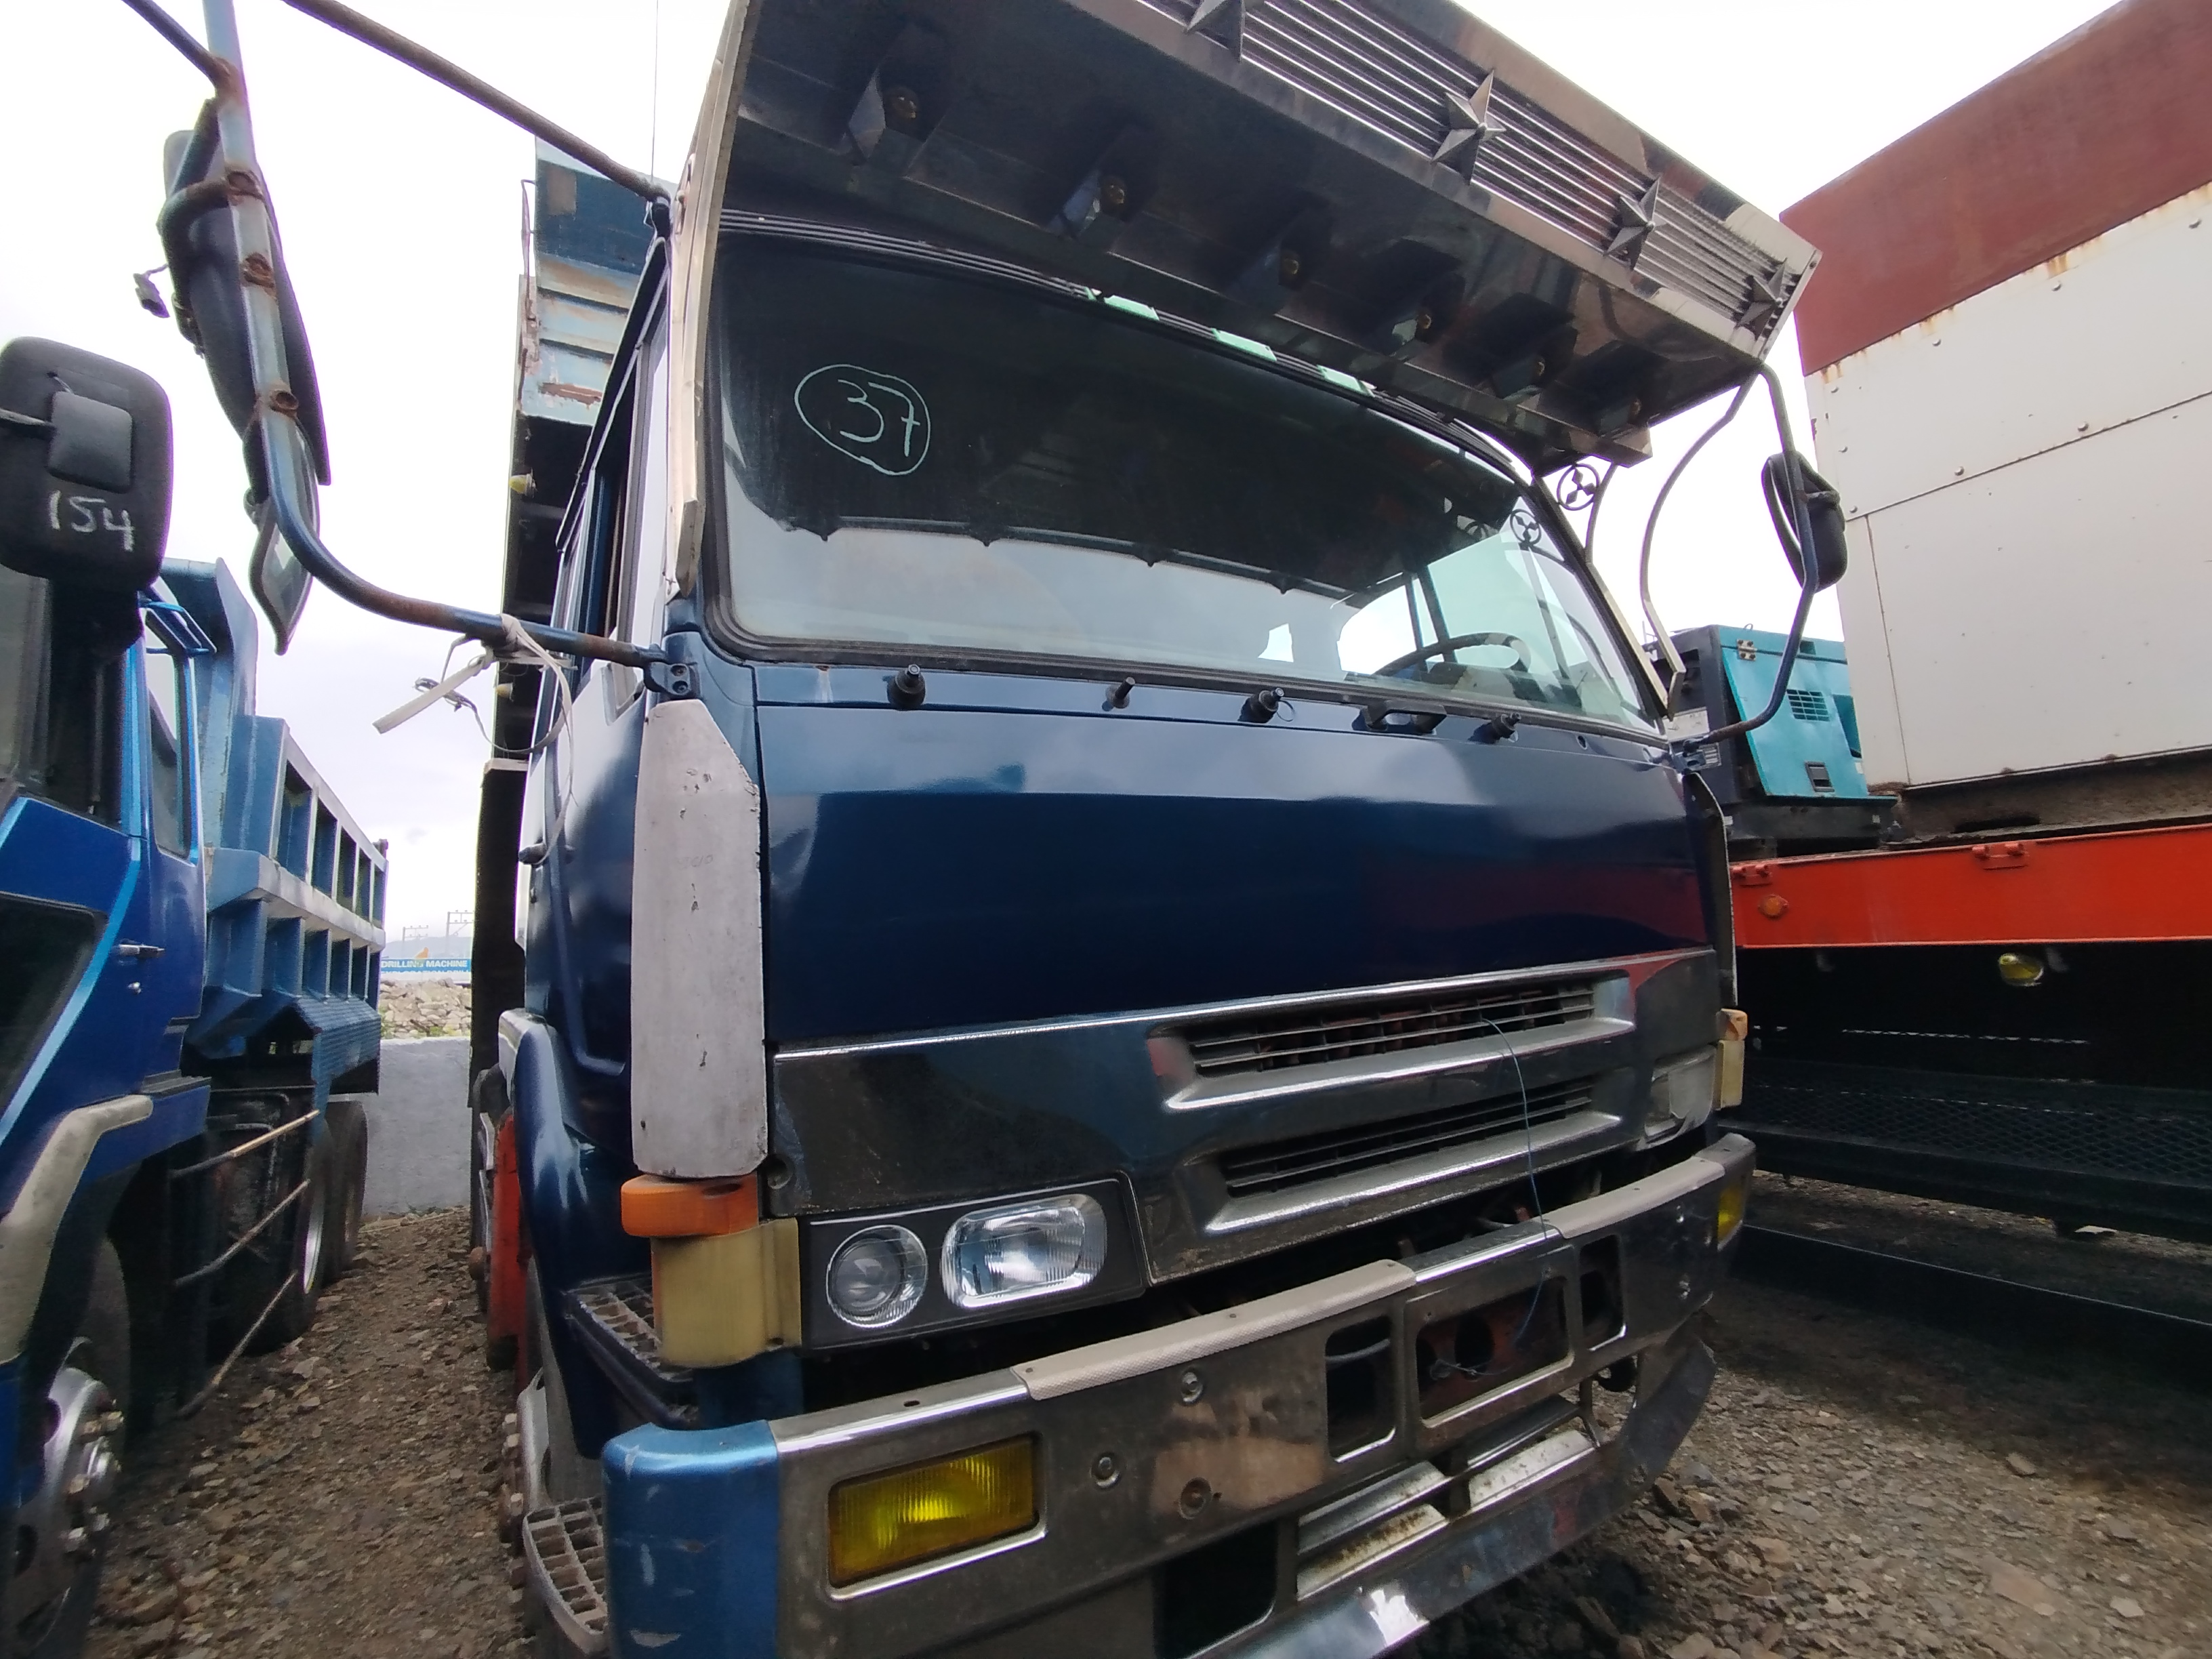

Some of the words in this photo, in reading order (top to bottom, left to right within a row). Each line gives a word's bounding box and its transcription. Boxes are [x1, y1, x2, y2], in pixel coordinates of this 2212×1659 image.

[838, 379, 920, 457] 37
[50, 489, 135, 552] 154
[381, 960, 424, 968] DRILLING
[426, 960, 468, 968] MACHINE
